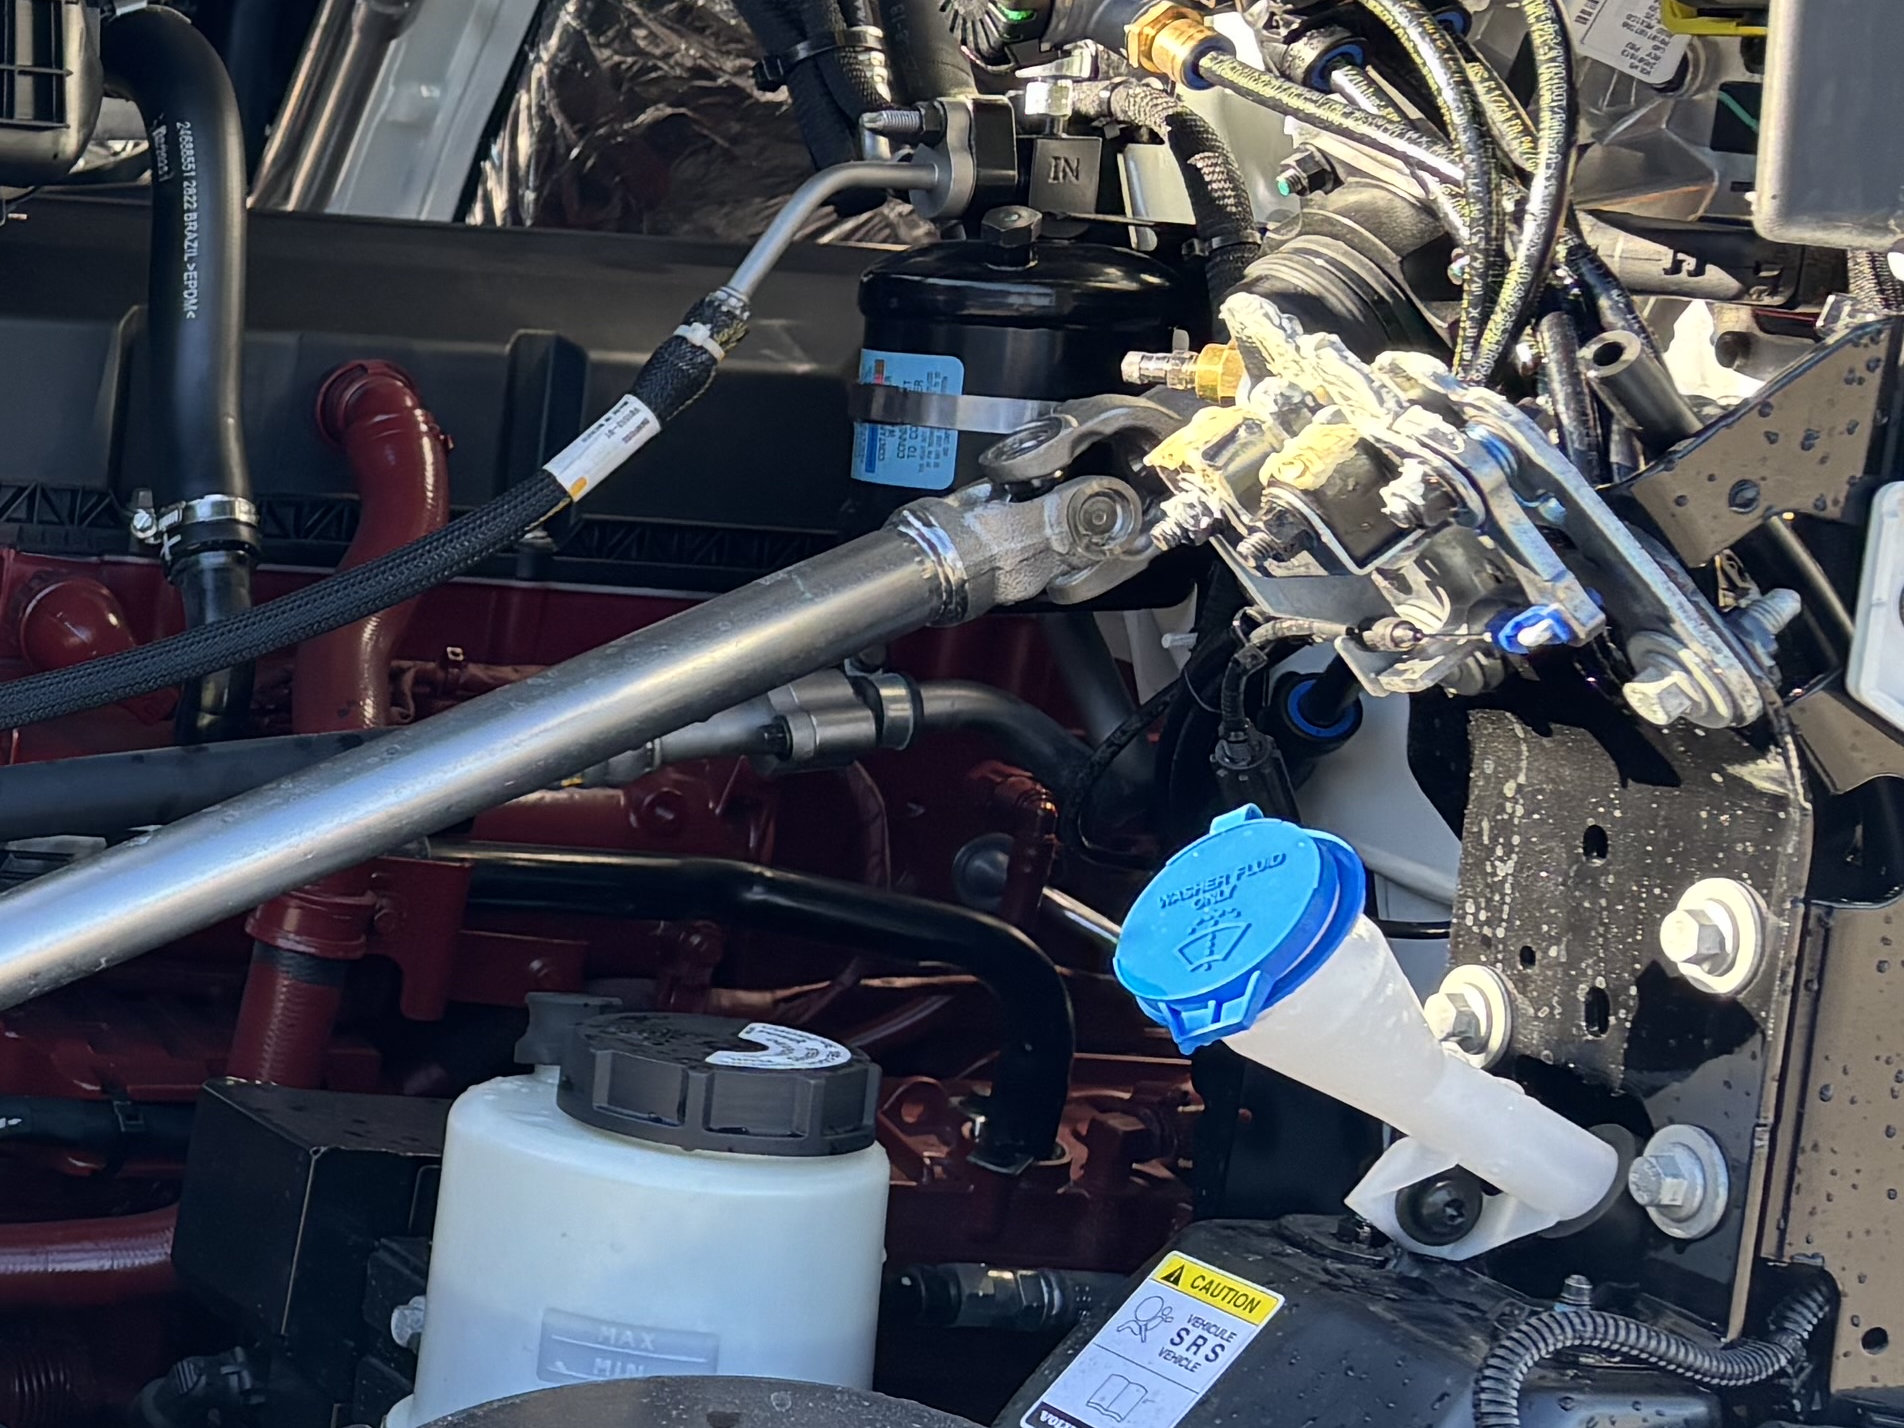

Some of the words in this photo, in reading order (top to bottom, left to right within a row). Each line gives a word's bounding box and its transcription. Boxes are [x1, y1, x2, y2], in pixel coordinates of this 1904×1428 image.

[1048, 155, 1081, 186] IN
[183, 211, 199, 262] BRAZIL
[1159, 874, 1232, 909] WASHER
[1236, 852, 1288, 879] FLUID
[1193, 884, 1238, 911] ONLY
[1190, 1274, 1263, 1314] CAUTION
[597, 1326, 655, 1351] MAX
[1187, 1313, 1238, 1344] VEHICULE
[593, 1357, 645, 1377] MIN
[1157, 1346, 1202, 1374] VEHICLE
